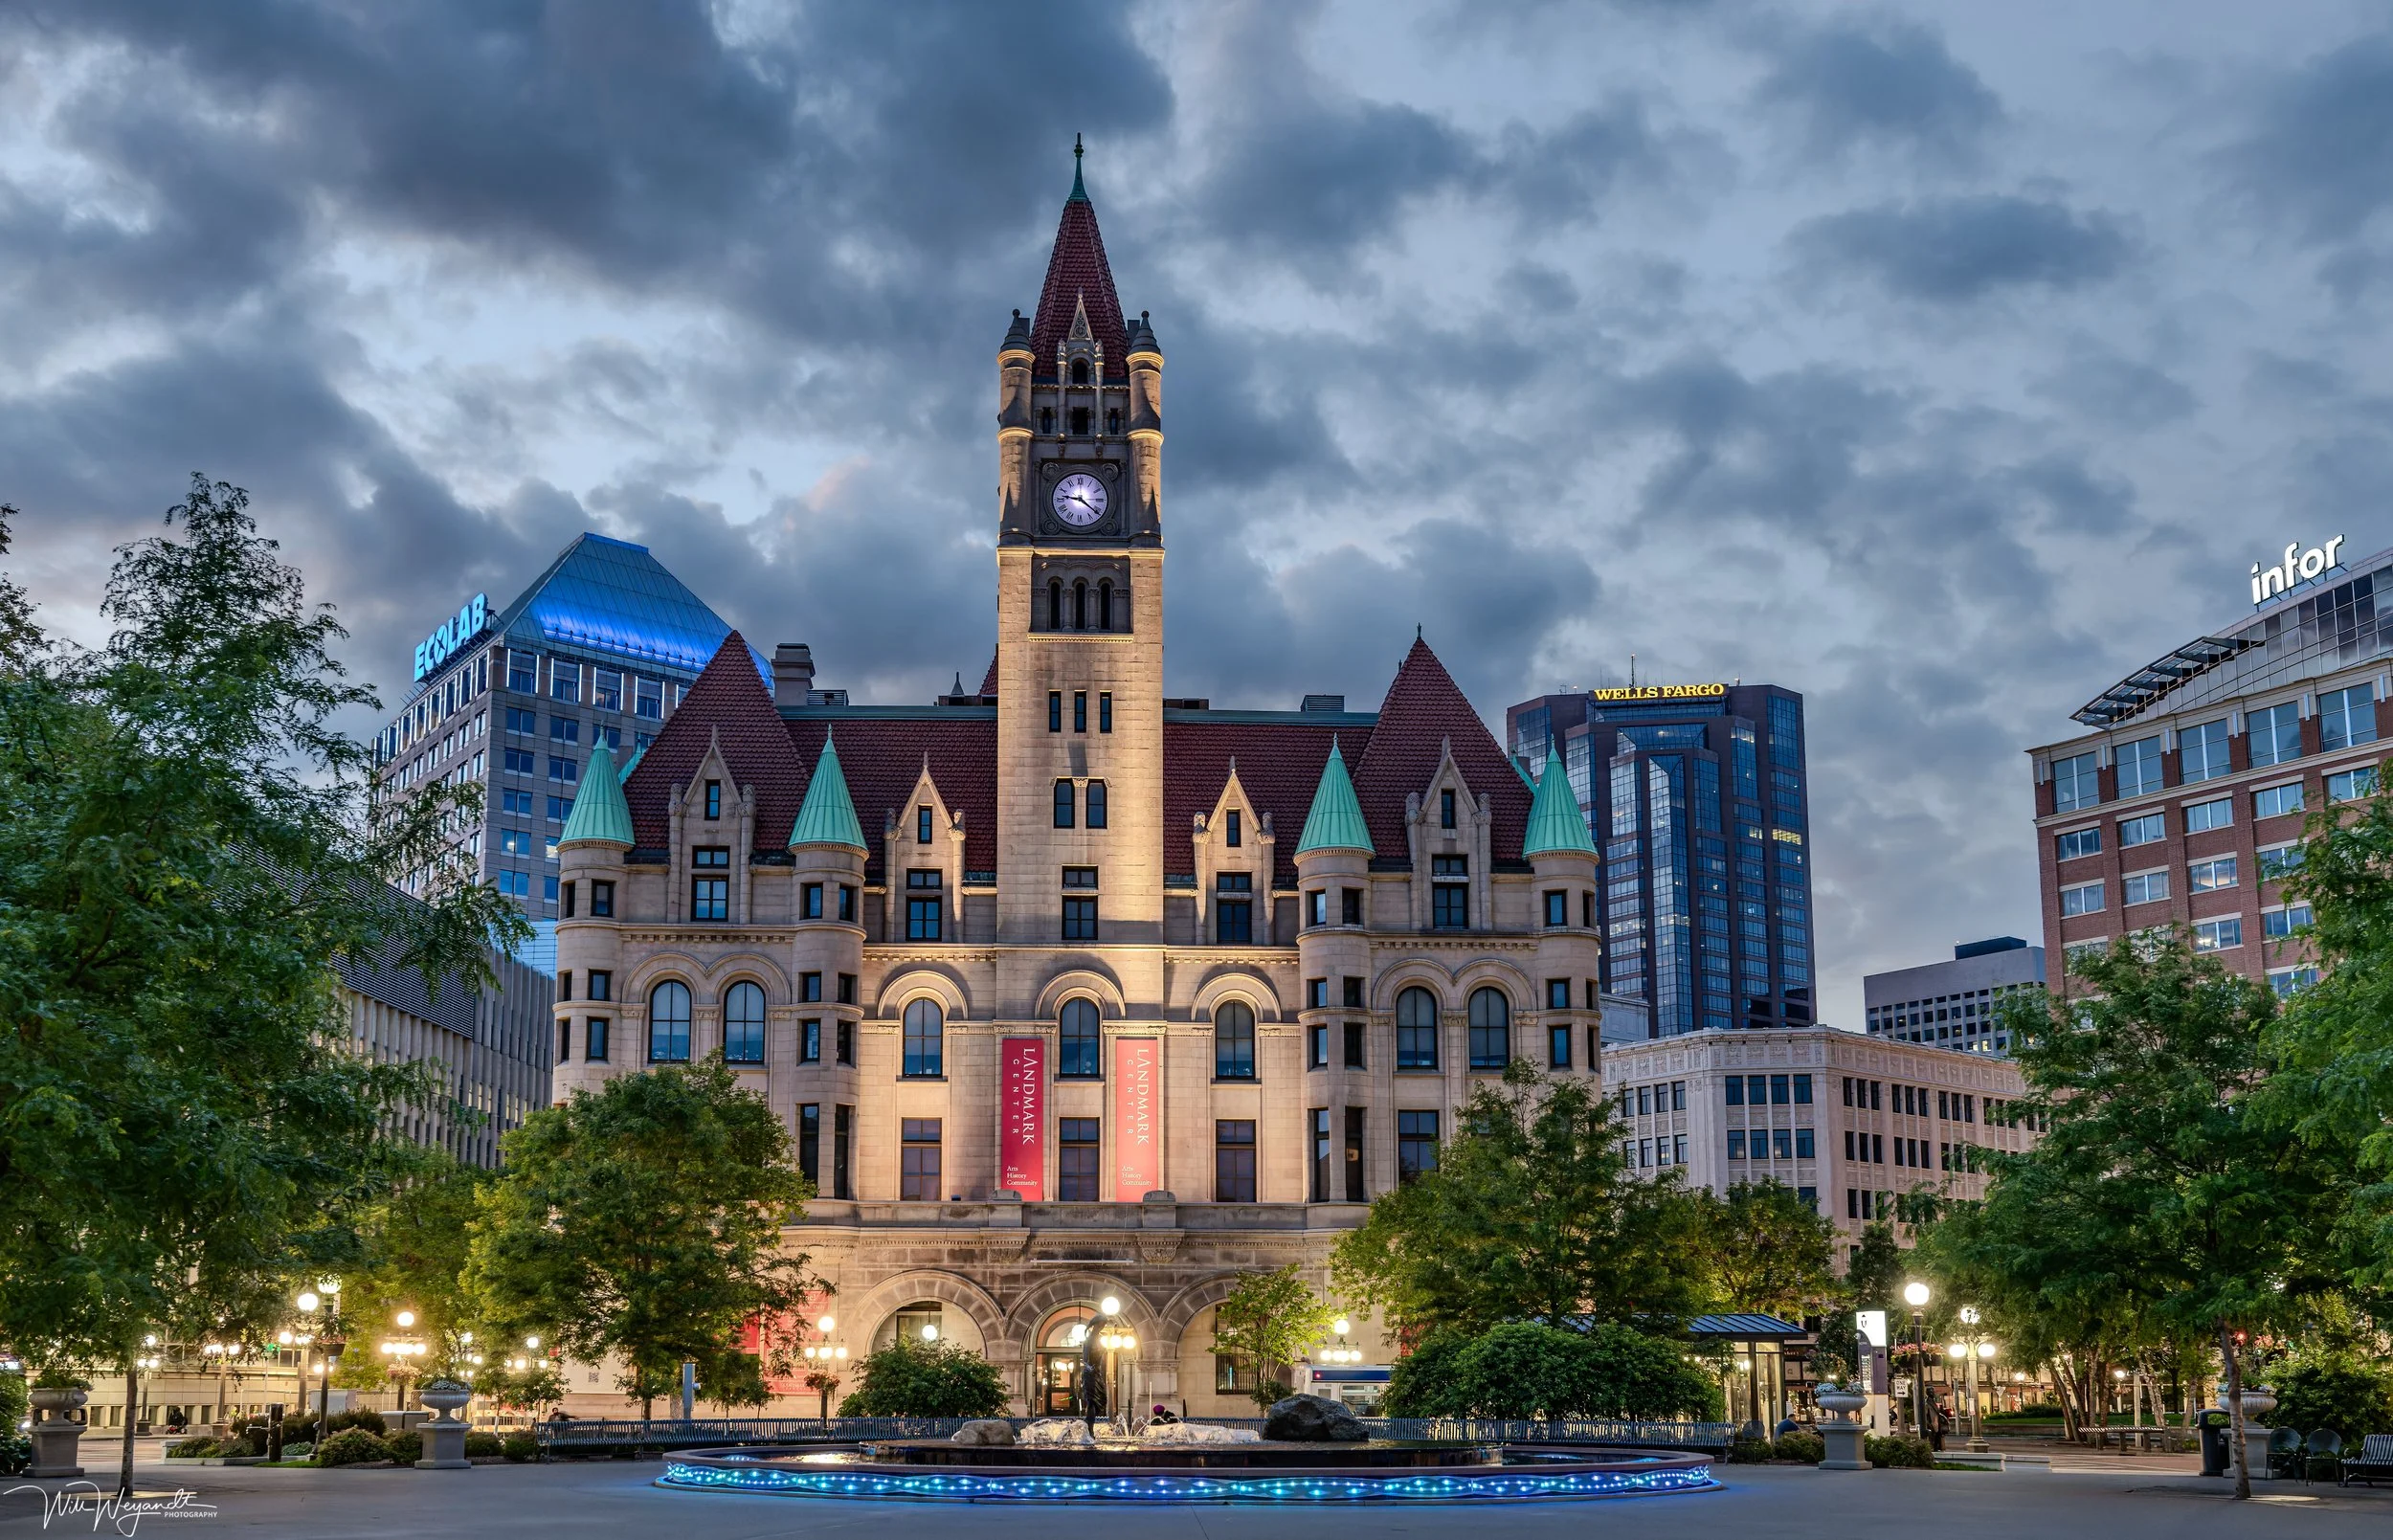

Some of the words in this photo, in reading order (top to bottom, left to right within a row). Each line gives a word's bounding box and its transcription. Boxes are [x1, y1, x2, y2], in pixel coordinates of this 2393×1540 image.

[2251, 534, 2344, 605] infor
[414, 592, 486, 682] ECOLAB
[1594, 686, 1658, 701] WELLS
[1662, 682, 1724, 698] FARGO
[1022, 1048, 1038, 1146] LANDMARK
[1137, 1048, 1152, 1146] LANDMARK
